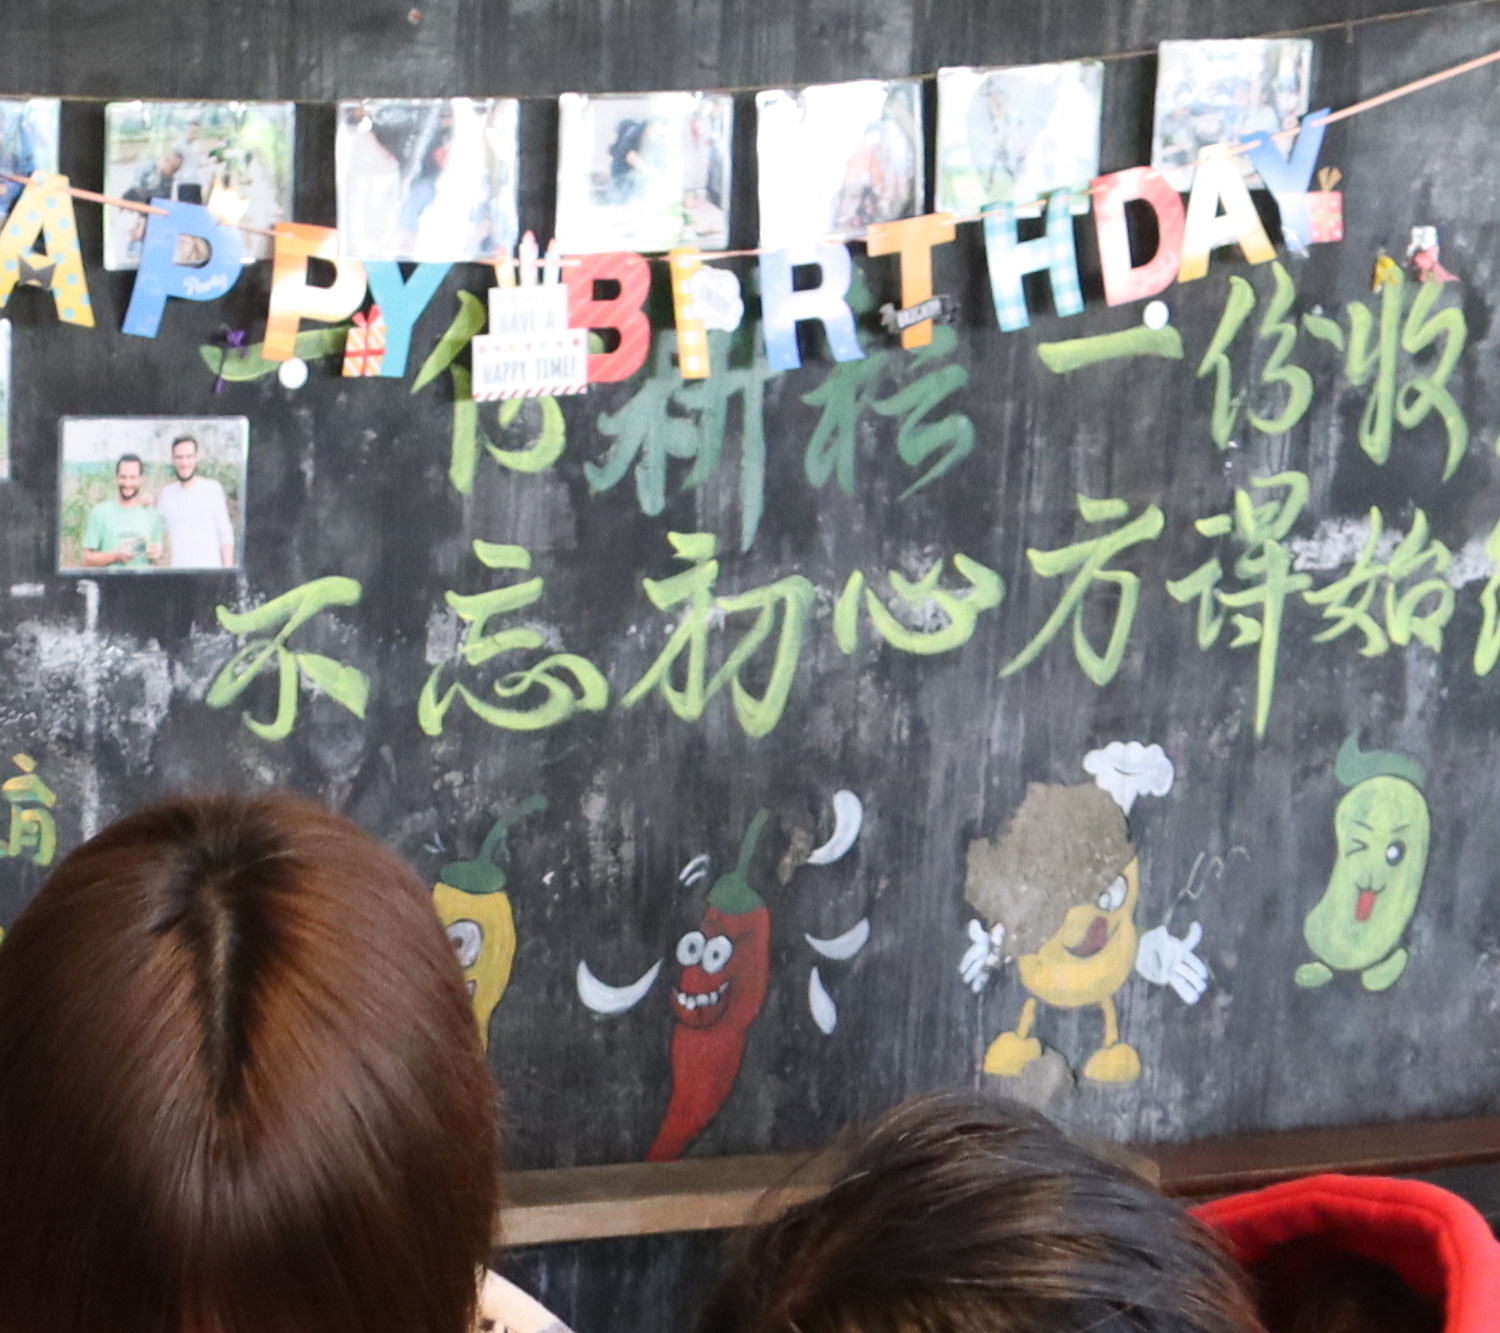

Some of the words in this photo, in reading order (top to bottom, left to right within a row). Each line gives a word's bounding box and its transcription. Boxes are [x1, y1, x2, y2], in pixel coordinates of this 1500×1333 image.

[558, 108, 1332, 383] BIRTHDAY
[483, 360, 527, 385] HAPPY
[535, 355, 576, 380] TIME!
